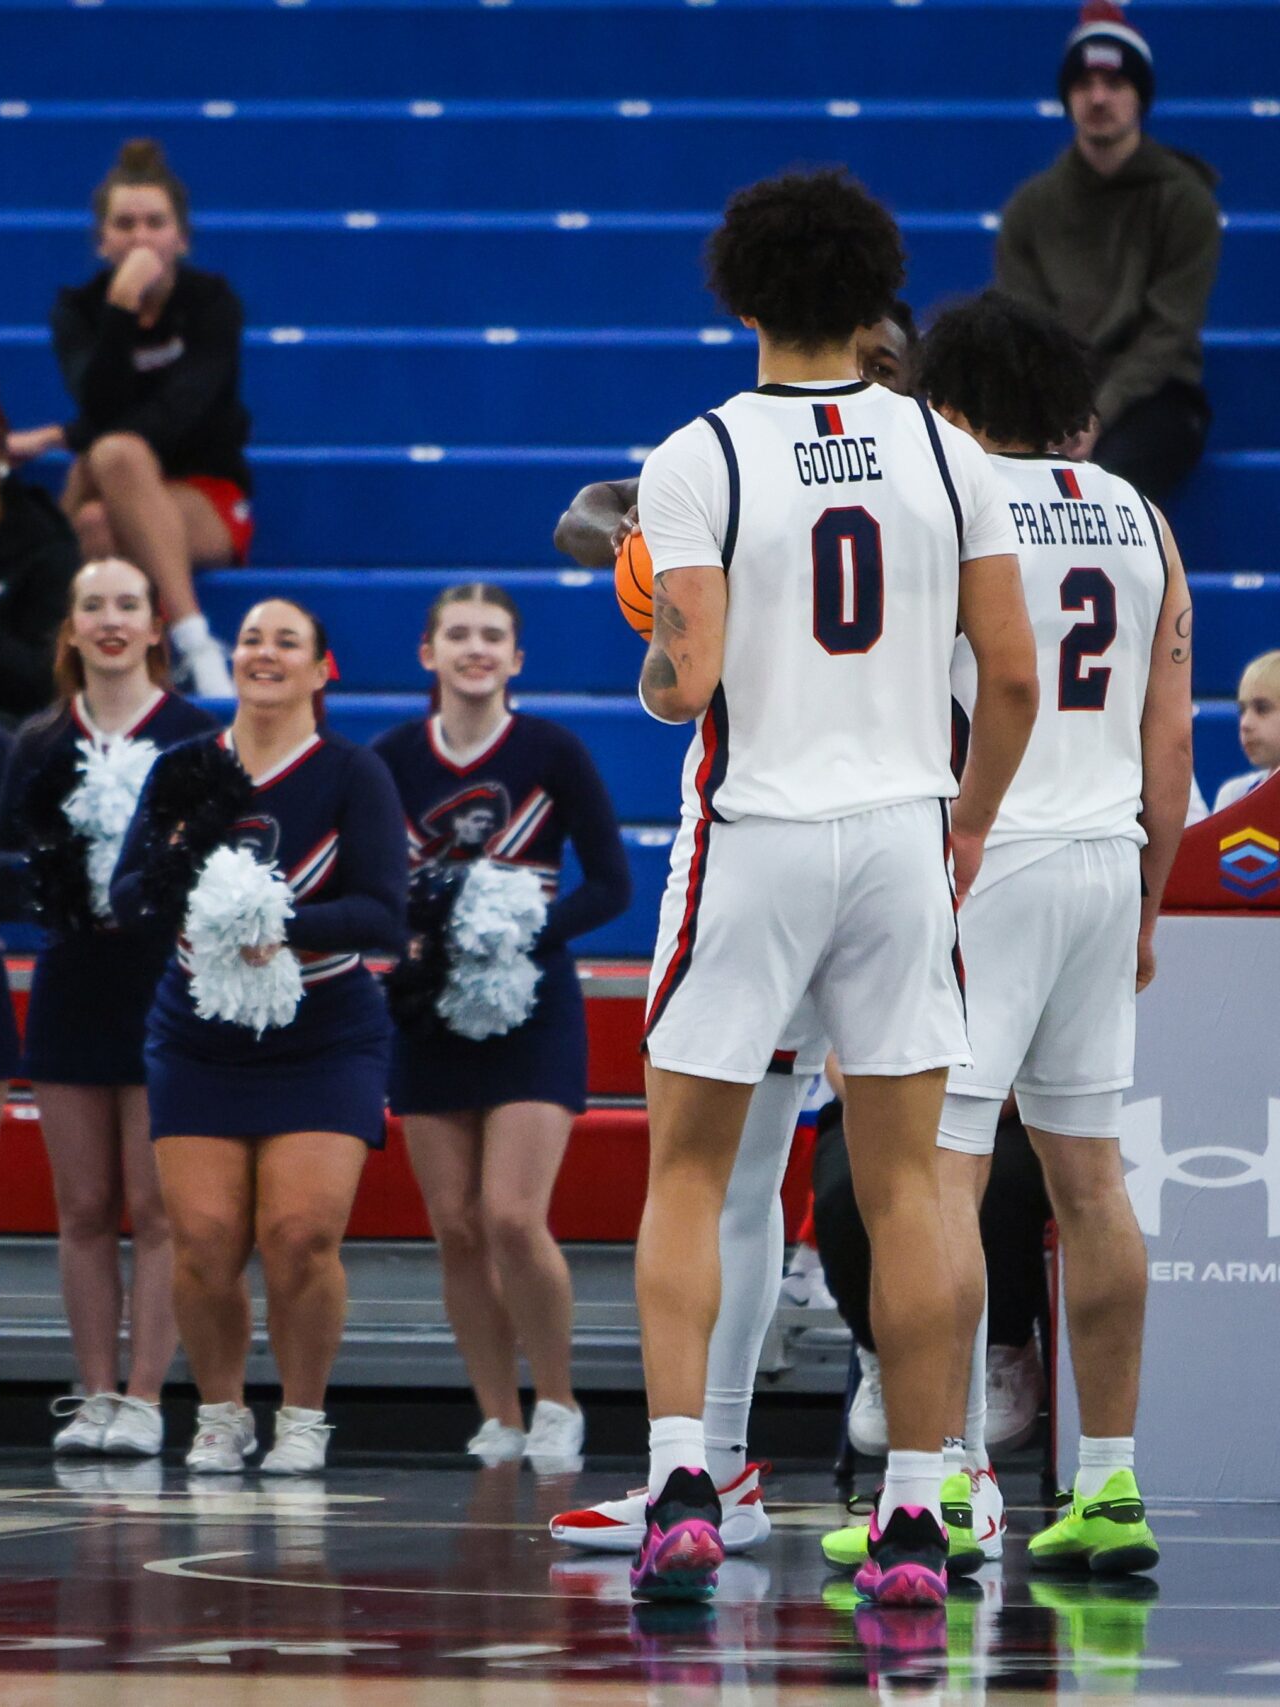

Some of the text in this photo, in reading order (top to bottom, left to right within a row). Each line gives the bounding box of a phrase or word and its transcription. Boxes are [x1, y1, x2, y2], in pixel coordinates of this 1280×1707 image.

[793, 436, 883, 486] GOODE
[1008, 502, 1147, 547] PRATHER JR.
[811, 505, 885, 656] 0
[1057, 566, 1118, 712] 2
[1148, 1261, 1280, 1282] ER ARM
